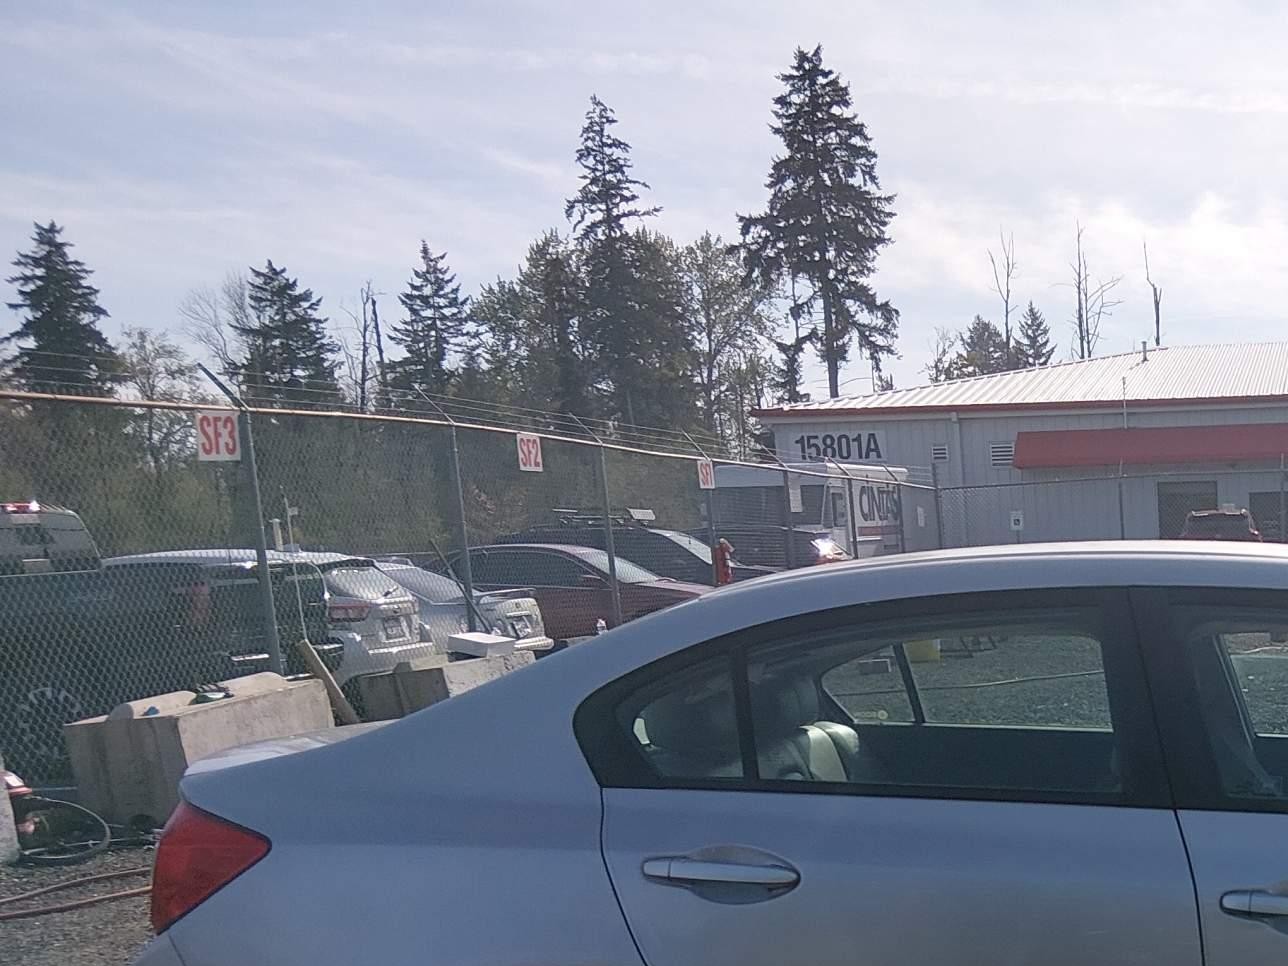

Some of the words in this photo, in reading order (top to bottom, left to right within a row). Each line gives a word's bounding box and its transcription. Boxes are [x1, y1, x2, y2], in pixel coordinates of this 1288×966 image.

[199, 415, 237, 455] SF3
[794, 433, 882, 461] 15801A
[519, 437, 541, 467] SF2
